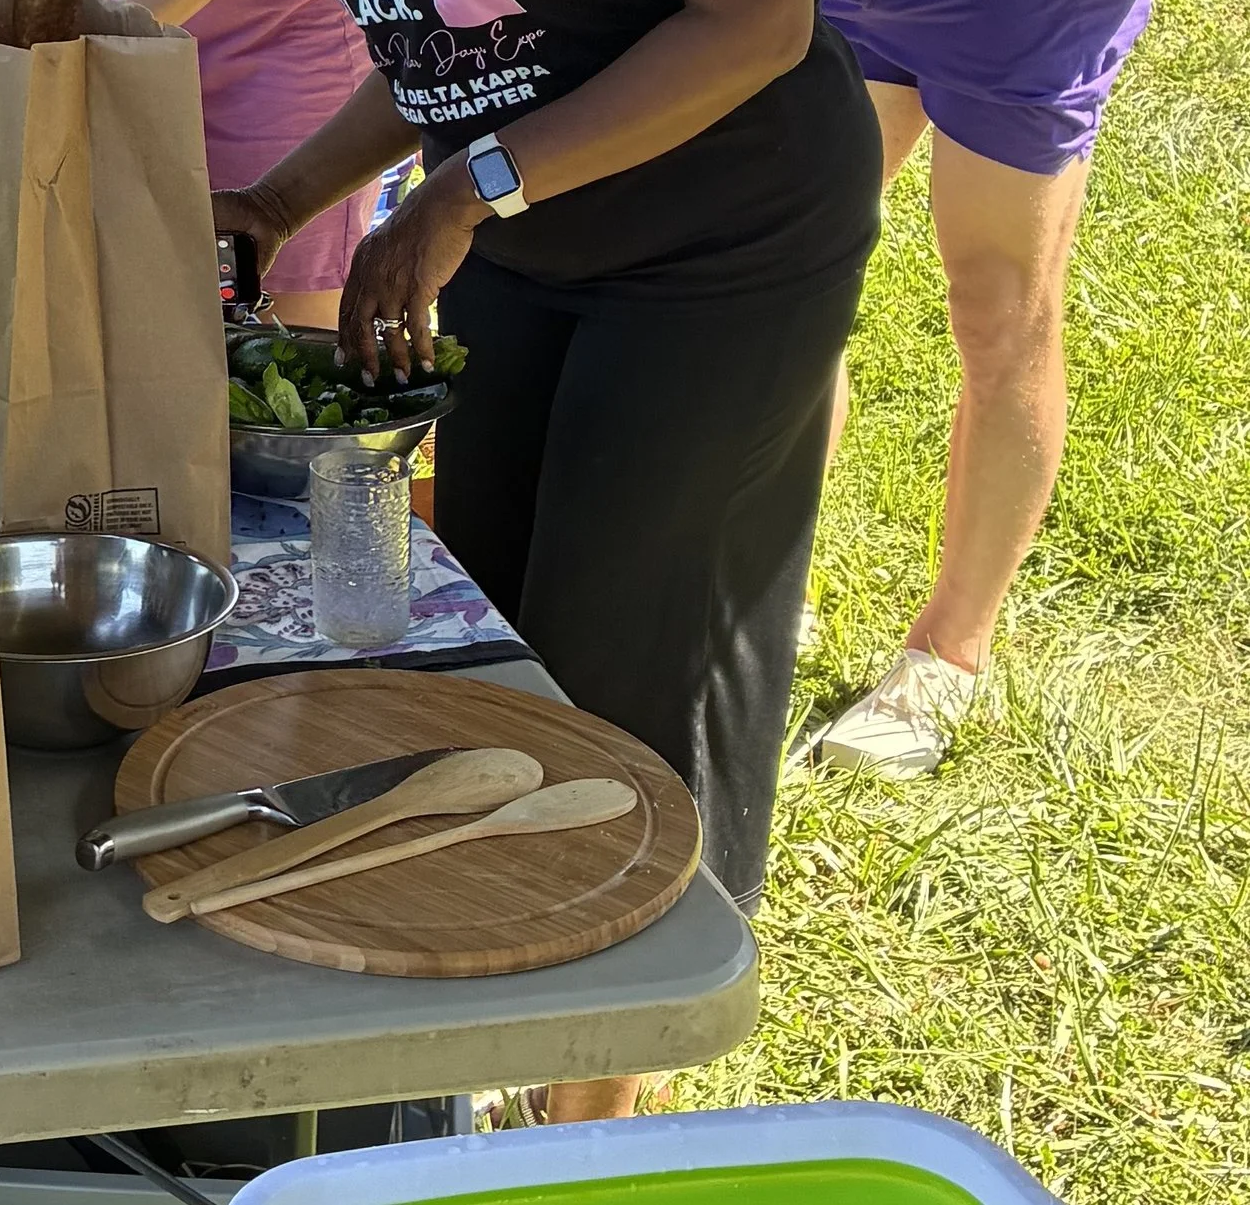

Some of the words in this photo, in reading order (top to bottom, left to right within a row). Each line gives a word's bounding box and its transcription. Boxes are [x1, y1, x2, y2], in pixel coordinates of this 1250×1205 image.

[490, 20, 547, 61] Expo
[395, 102, 429, 124] EGA
[430, 83, 537, 123] CHAPTER
[407, 83, 467, 105] DELTA
[468, 65, 551, 94] KAPPA
